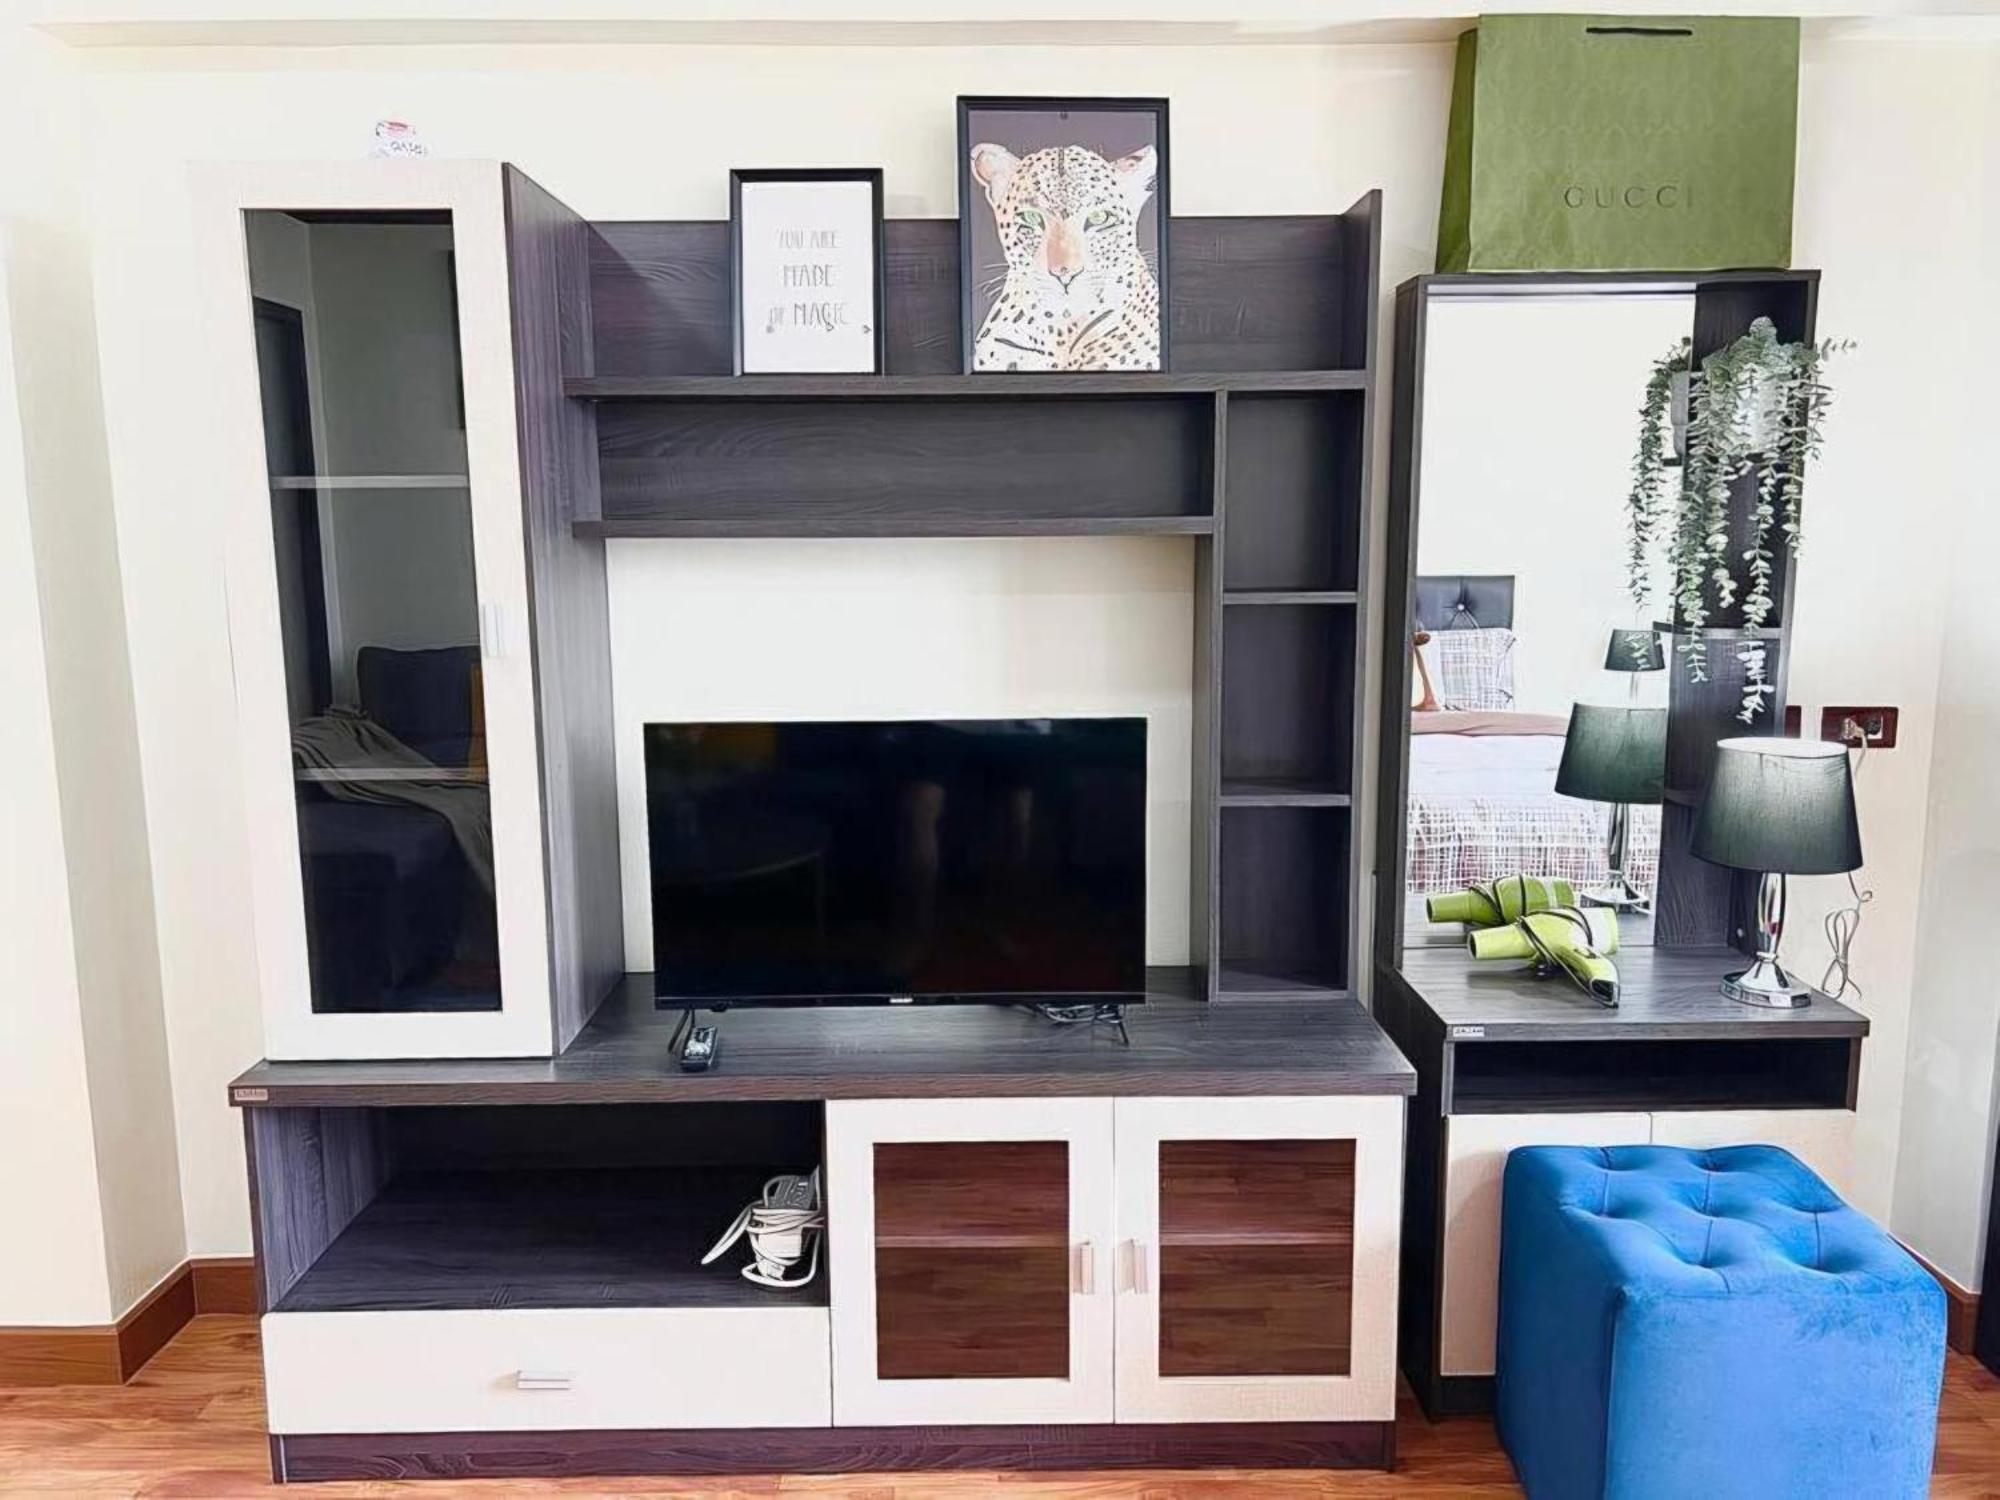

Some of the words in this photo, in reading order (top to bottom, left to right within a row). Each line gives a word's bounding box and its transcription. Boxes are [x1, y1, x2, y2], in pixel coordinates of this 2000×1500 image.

[1564, 185, 1693, 209] GUCCI
[776, 228, 804, 249] YOU
[783, 264, 834, 288] MADE
[794, 302, 850, 331] MAGIC
